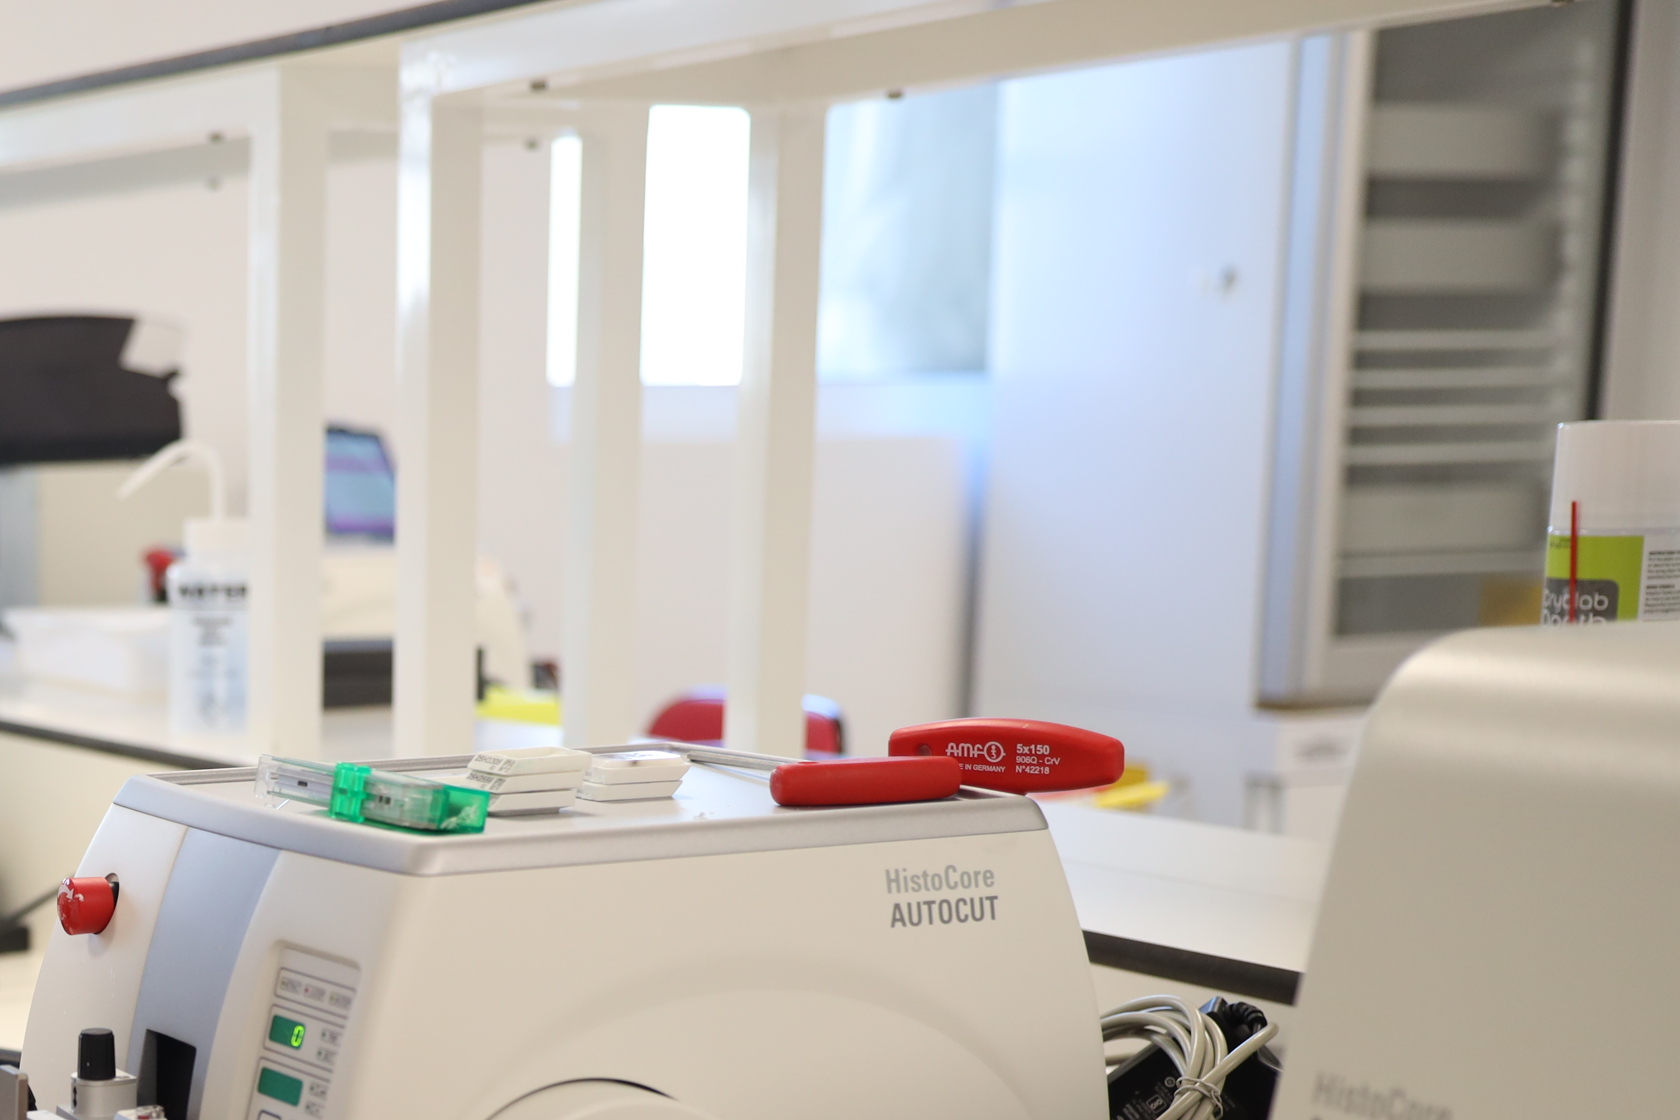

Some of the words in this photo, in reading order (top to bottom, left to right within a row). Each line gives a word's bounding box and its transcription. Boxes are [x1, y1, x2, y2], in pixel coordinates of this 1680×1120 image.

[1016, 743, 1050, 755] 5x150
[1044, 756, 1060, 765] CrV
[973, 764, 1006, 773] GERMANY
[1015, 765, 1050, 775] N°42218
[885, 864, 996, 895] HistoCore
[890, 895, 999, 928] AUTOCUT
[290, 1025, 306, 1048] 0
